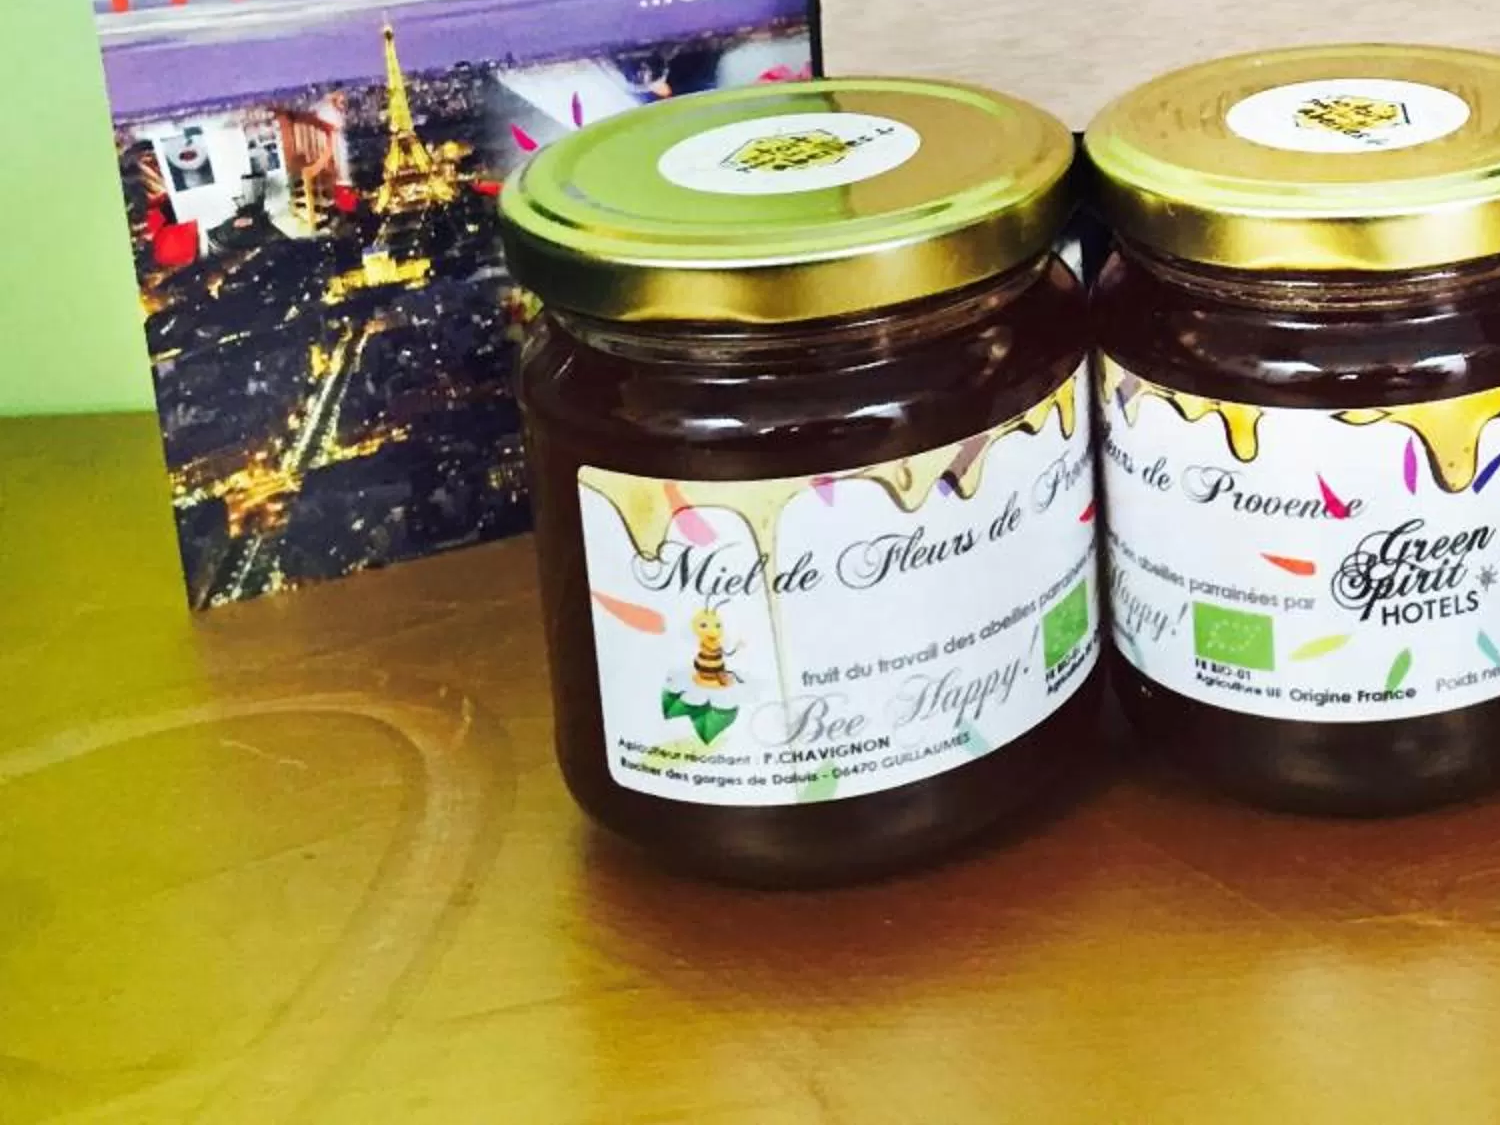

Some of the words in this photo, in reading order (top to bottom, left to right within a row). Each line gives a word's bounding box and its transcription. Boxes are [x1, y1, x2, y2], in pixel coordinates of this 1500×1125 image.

[1142, 457, 1172, 491] de
[631, 540, 766, 598] Miel
[773, 553, 823, 594] de
[836, 530, 979, 589] Fleurs
[990, 491, 1021, 542] de
[1356, 518, 1496, 575] Green
[1284, 596, 1316, 612] par
[1331, 551, 1468, 622] Spirit
[1381, 590, 1479, 626] HOTELS
[802, 665, 840, 687] fruit
[845, 659, 872, 680] du
[878, 643, 938, 675] travail
[943, 628, 976, 658] des
[979, 599, 1037, 641] abeilles
[749, 694, 865, 752] Bee
[893, 623, 1040, 745] Happy!
[1289, 688, 1351, 707] Origine
[1357, 686, 1417, 704] France
[1436, 672, 1479, 692] Poids
[747, 774, 767, 786] de
